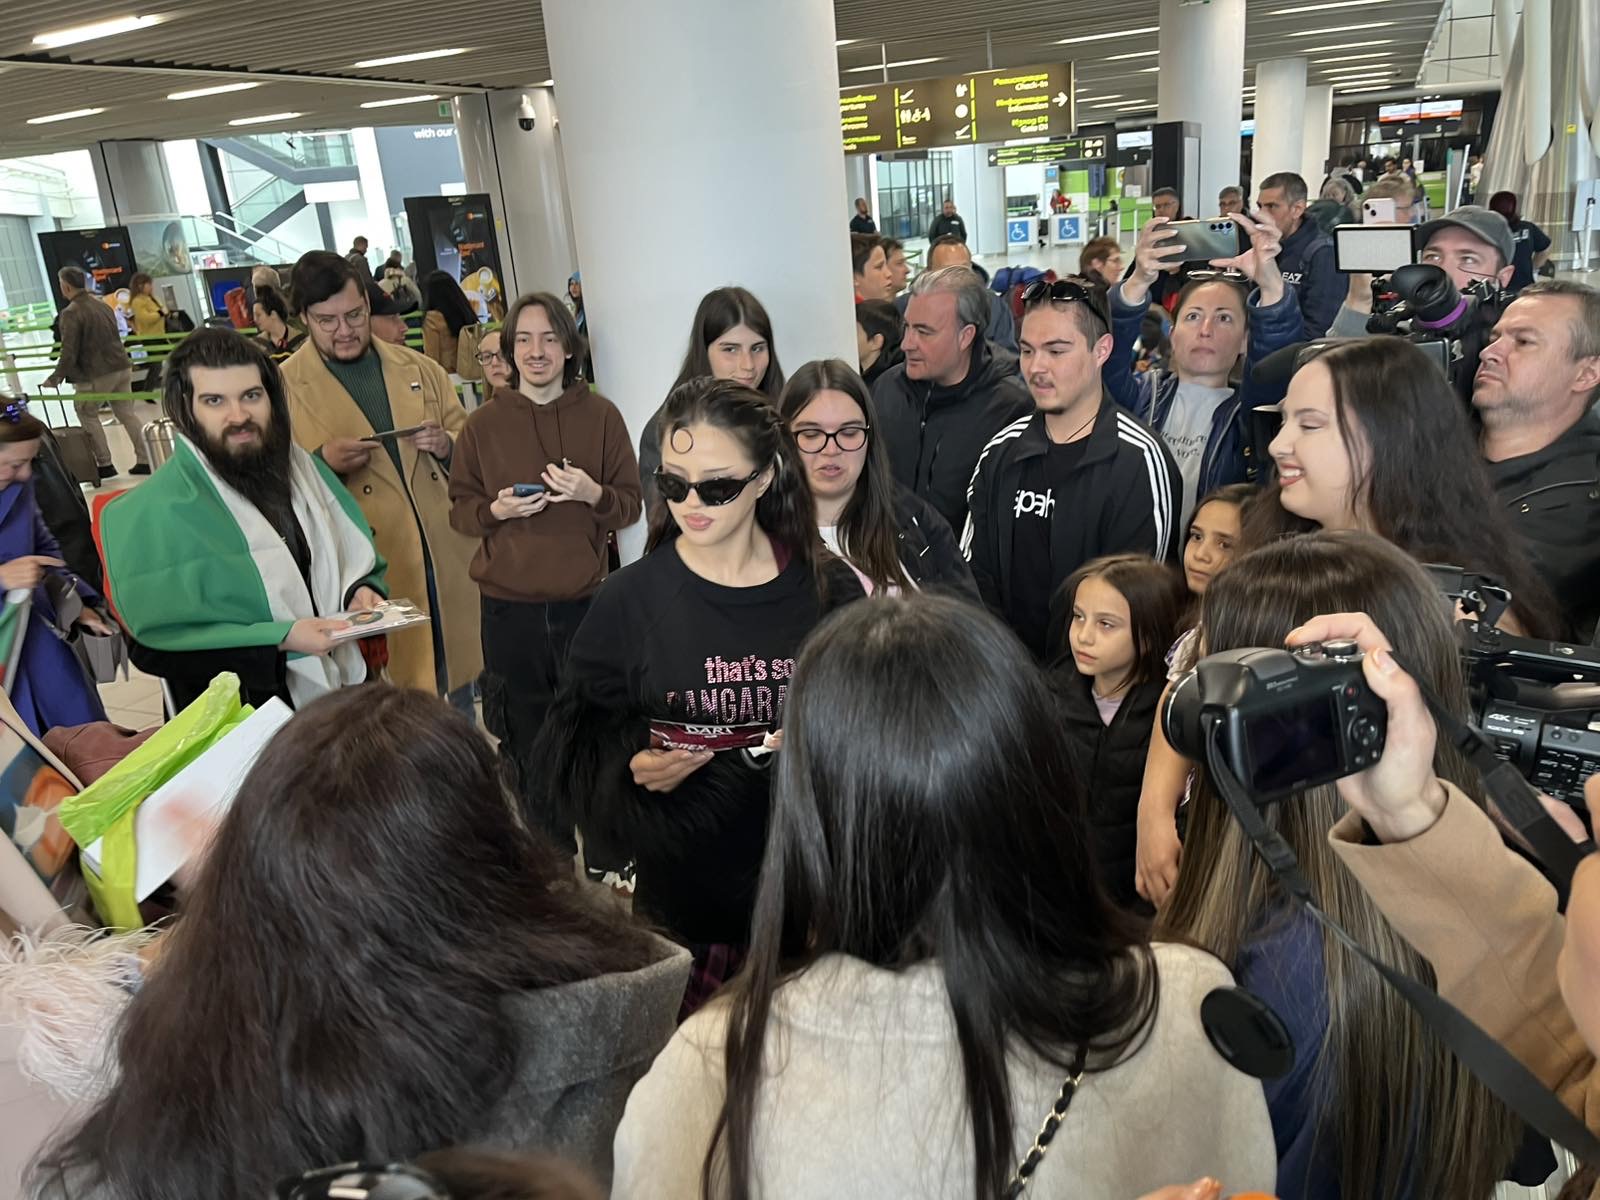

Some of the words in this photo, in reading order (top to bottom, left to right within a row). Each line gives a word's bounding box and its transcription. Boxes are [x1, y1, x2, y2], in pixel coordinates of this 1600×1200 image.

[413, 128, 435, 139] with
[704, 654, 768, 684] that's
[771, 658, 795, 680] so
